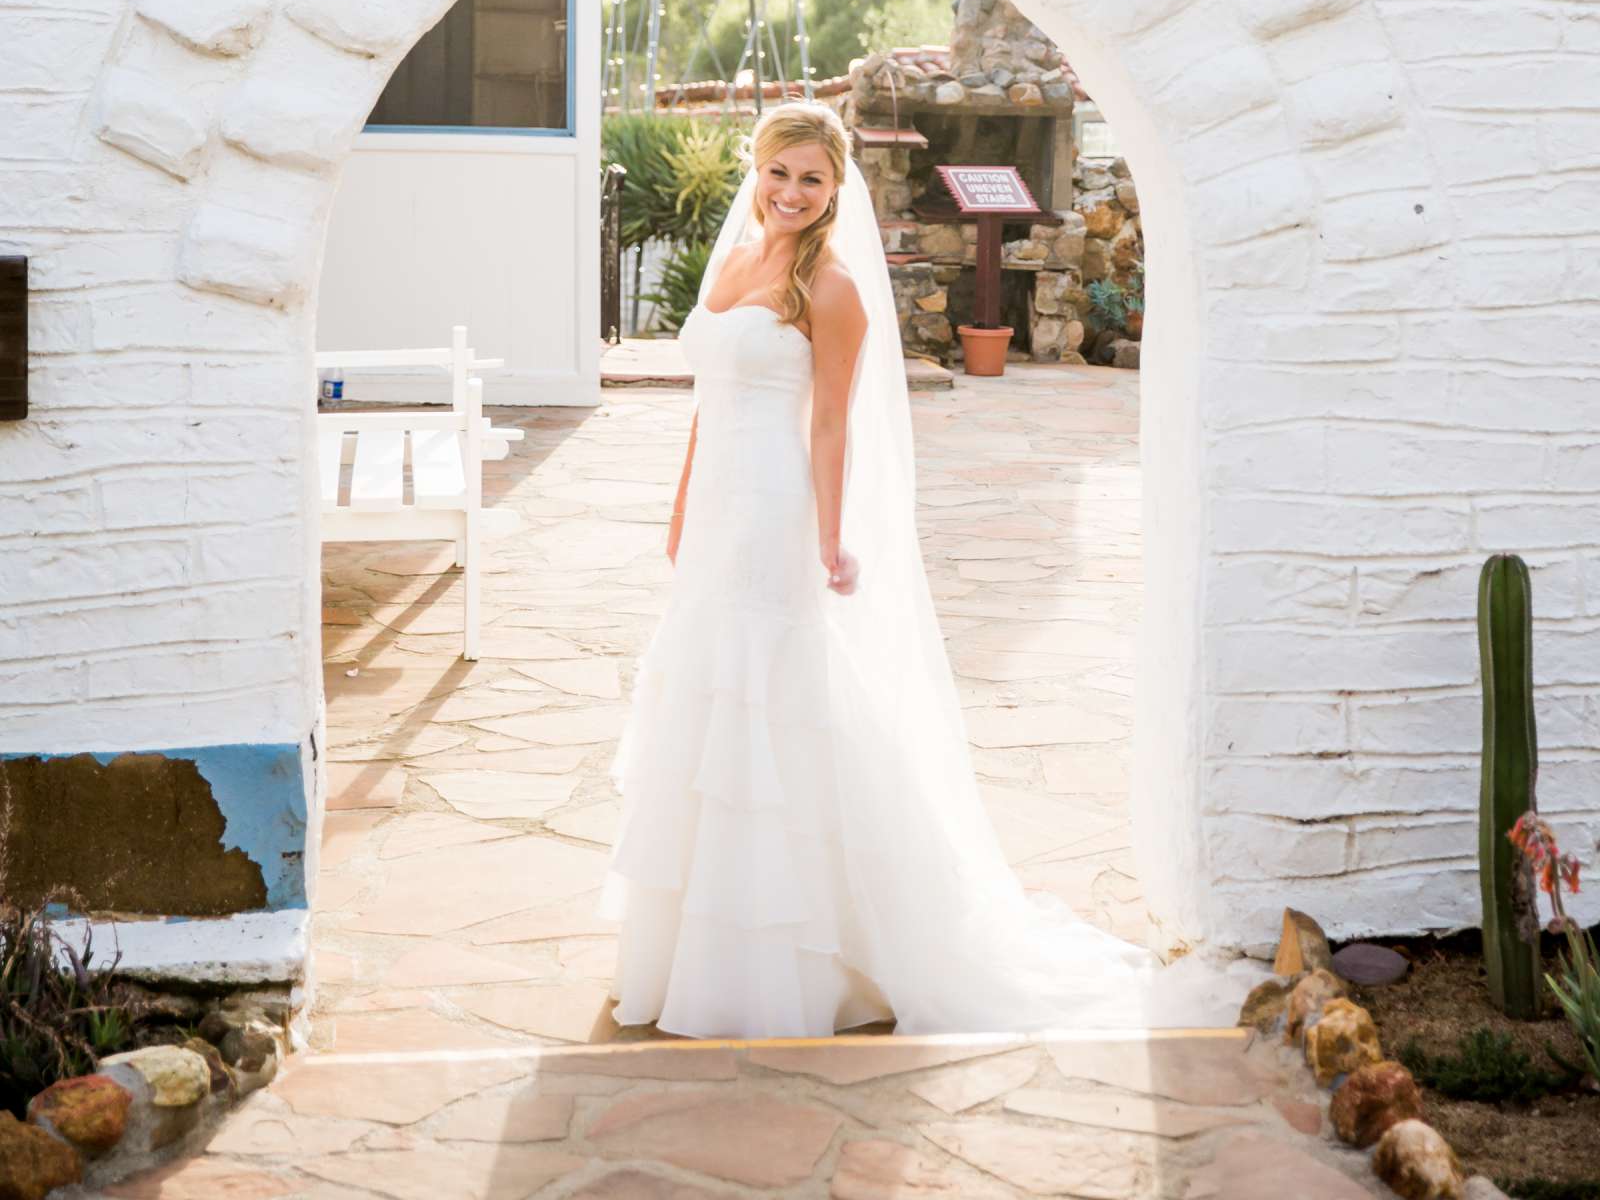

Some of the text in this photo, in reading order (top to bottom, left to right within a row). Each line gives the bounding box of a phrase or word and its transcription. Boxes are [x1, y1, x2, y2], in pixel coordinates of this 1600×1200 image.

[958, 173, 1008, 183] CAUTION
[966, 183, 1013, 193] UNEVEN
[976, 193, 1017, 203] STAIRS
